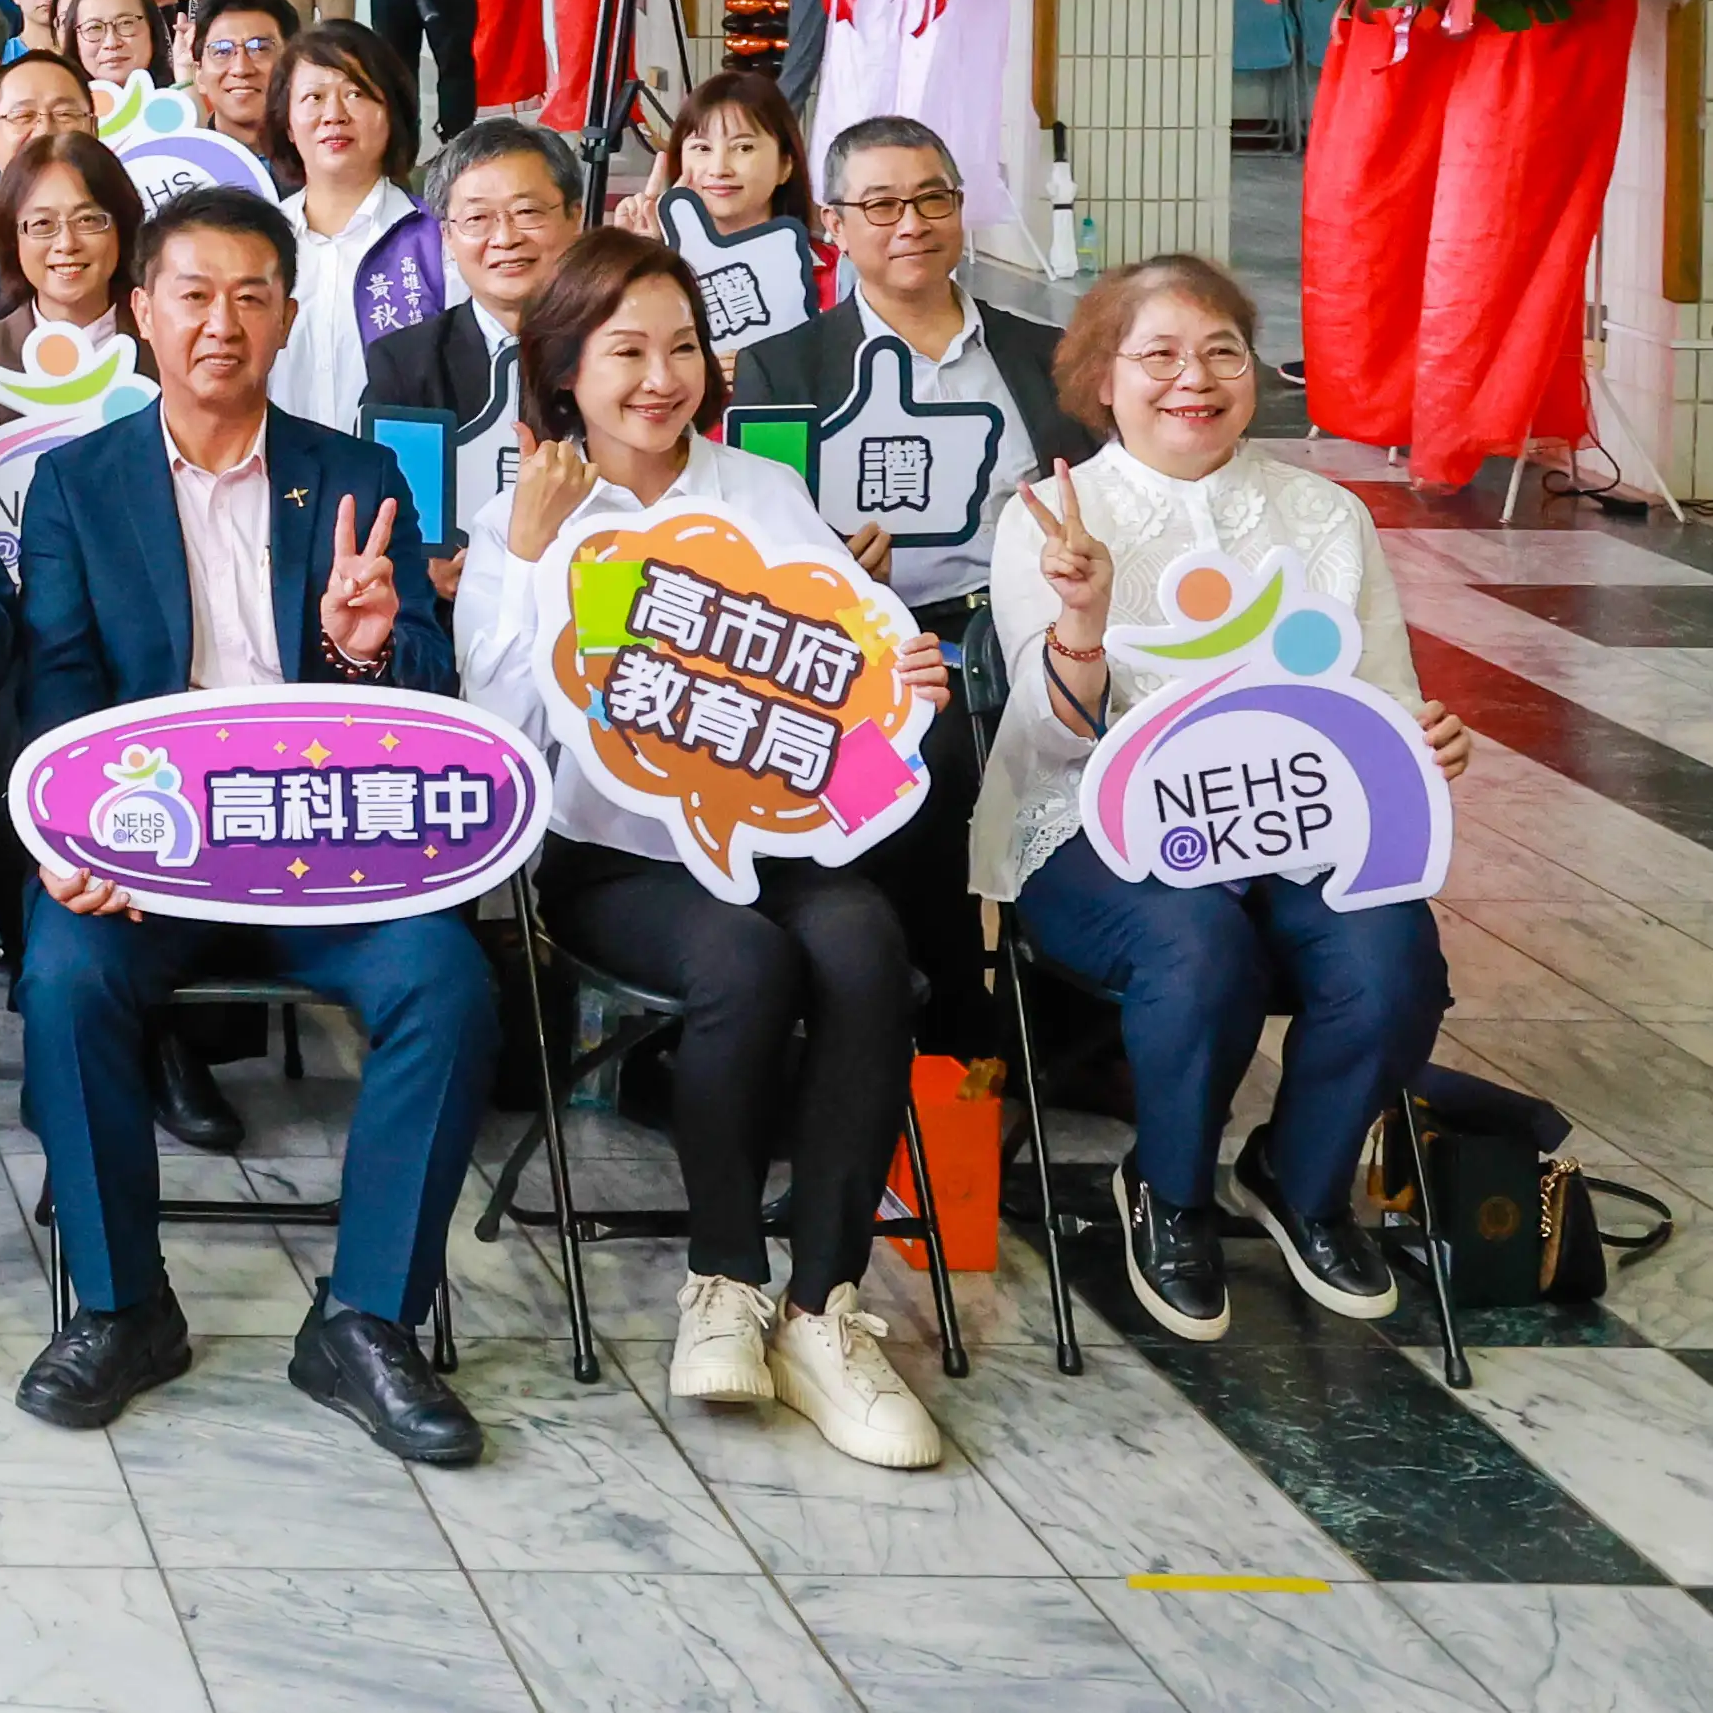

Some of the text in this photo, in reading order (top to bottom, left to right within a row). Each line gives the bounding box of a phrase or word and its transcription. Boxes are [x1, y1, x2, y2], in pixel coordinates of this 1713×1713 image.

[861, 440, 928, 510] 讚
[633, 566, 860, 699] 高市府
[606, 652, 841, 792] 教育局
[113, 812, 164, 828] NEHS
[210, 772, 489, 841] 高科實中
[1154, 752, 1328, 822] NEHS
[1161, 802, 1332, 871] @KSP
